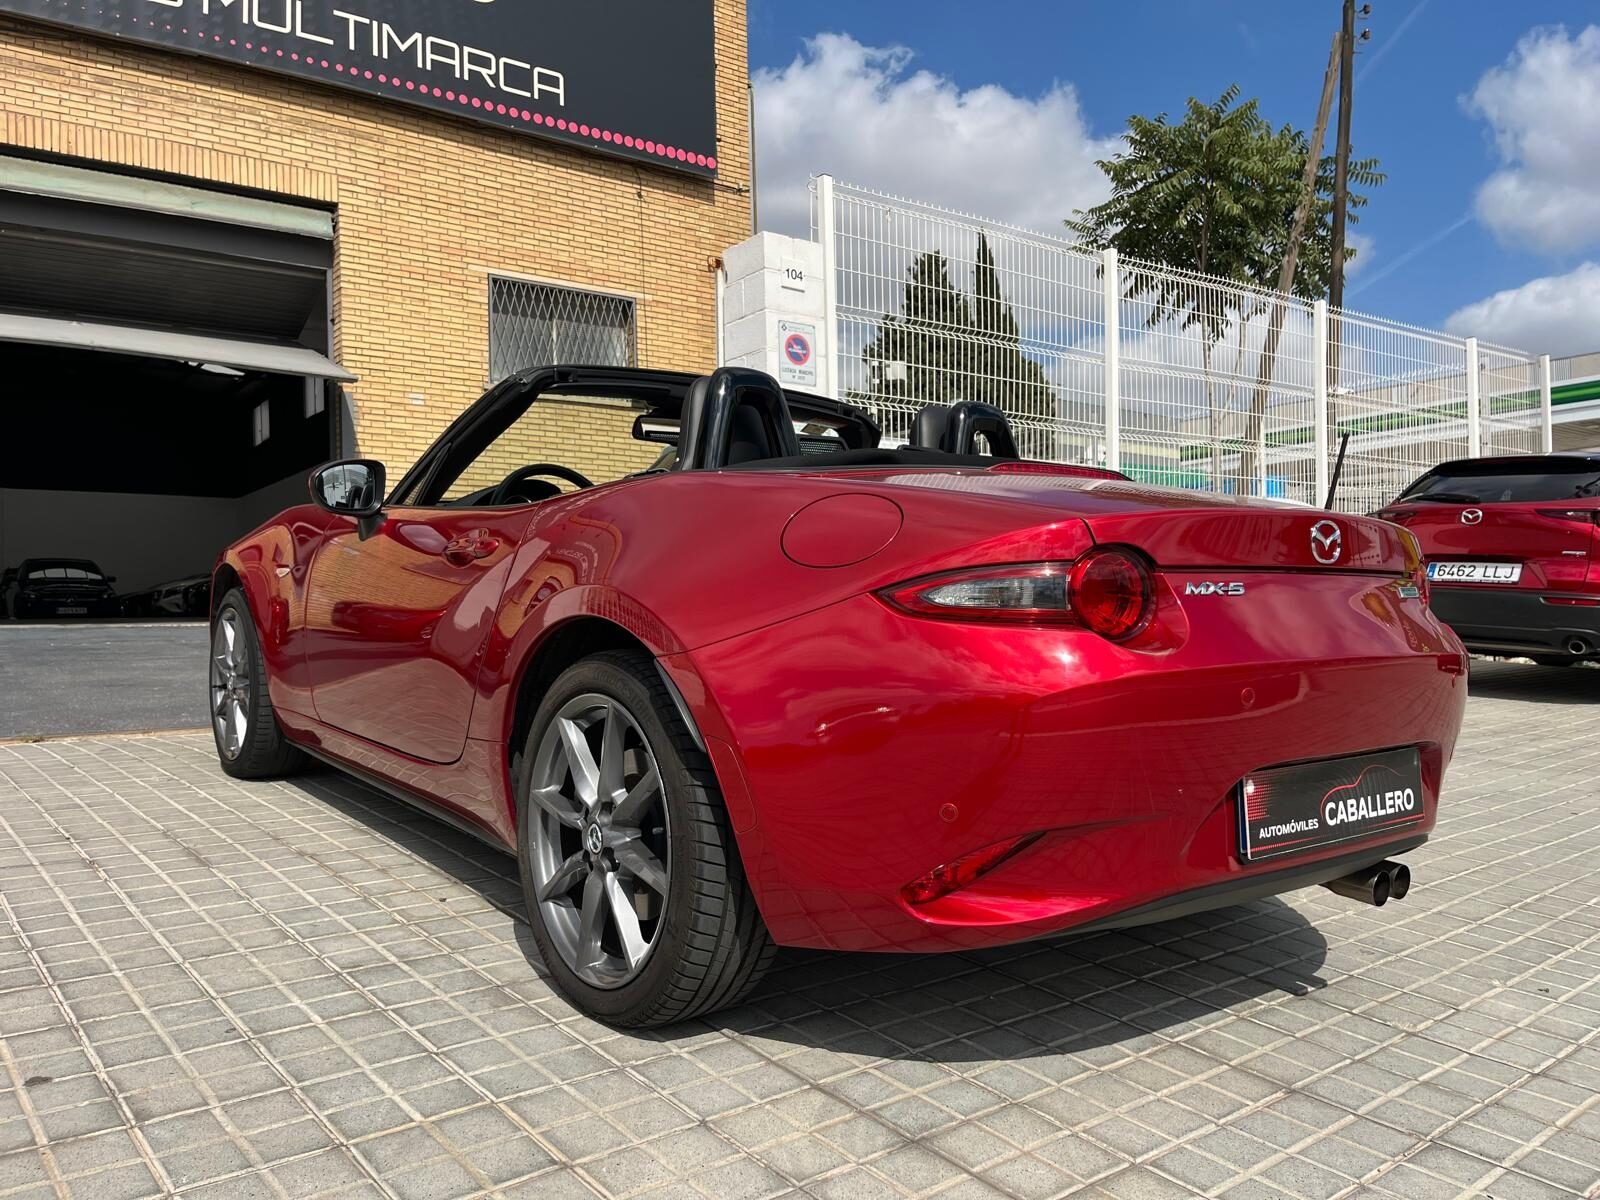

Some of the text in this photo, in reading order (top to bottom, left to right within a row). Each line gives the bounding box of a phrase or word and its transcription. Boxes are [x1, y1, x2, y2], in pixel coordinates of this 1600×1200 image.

[785, 268, 804, 281] 104
[1437, 564, 1515, 579] 6462 LLJ
[1184, 581, 1246, 596] MX-5
[1259, 787, 1415, 839] AUTOMÓVILES CABALLERO
